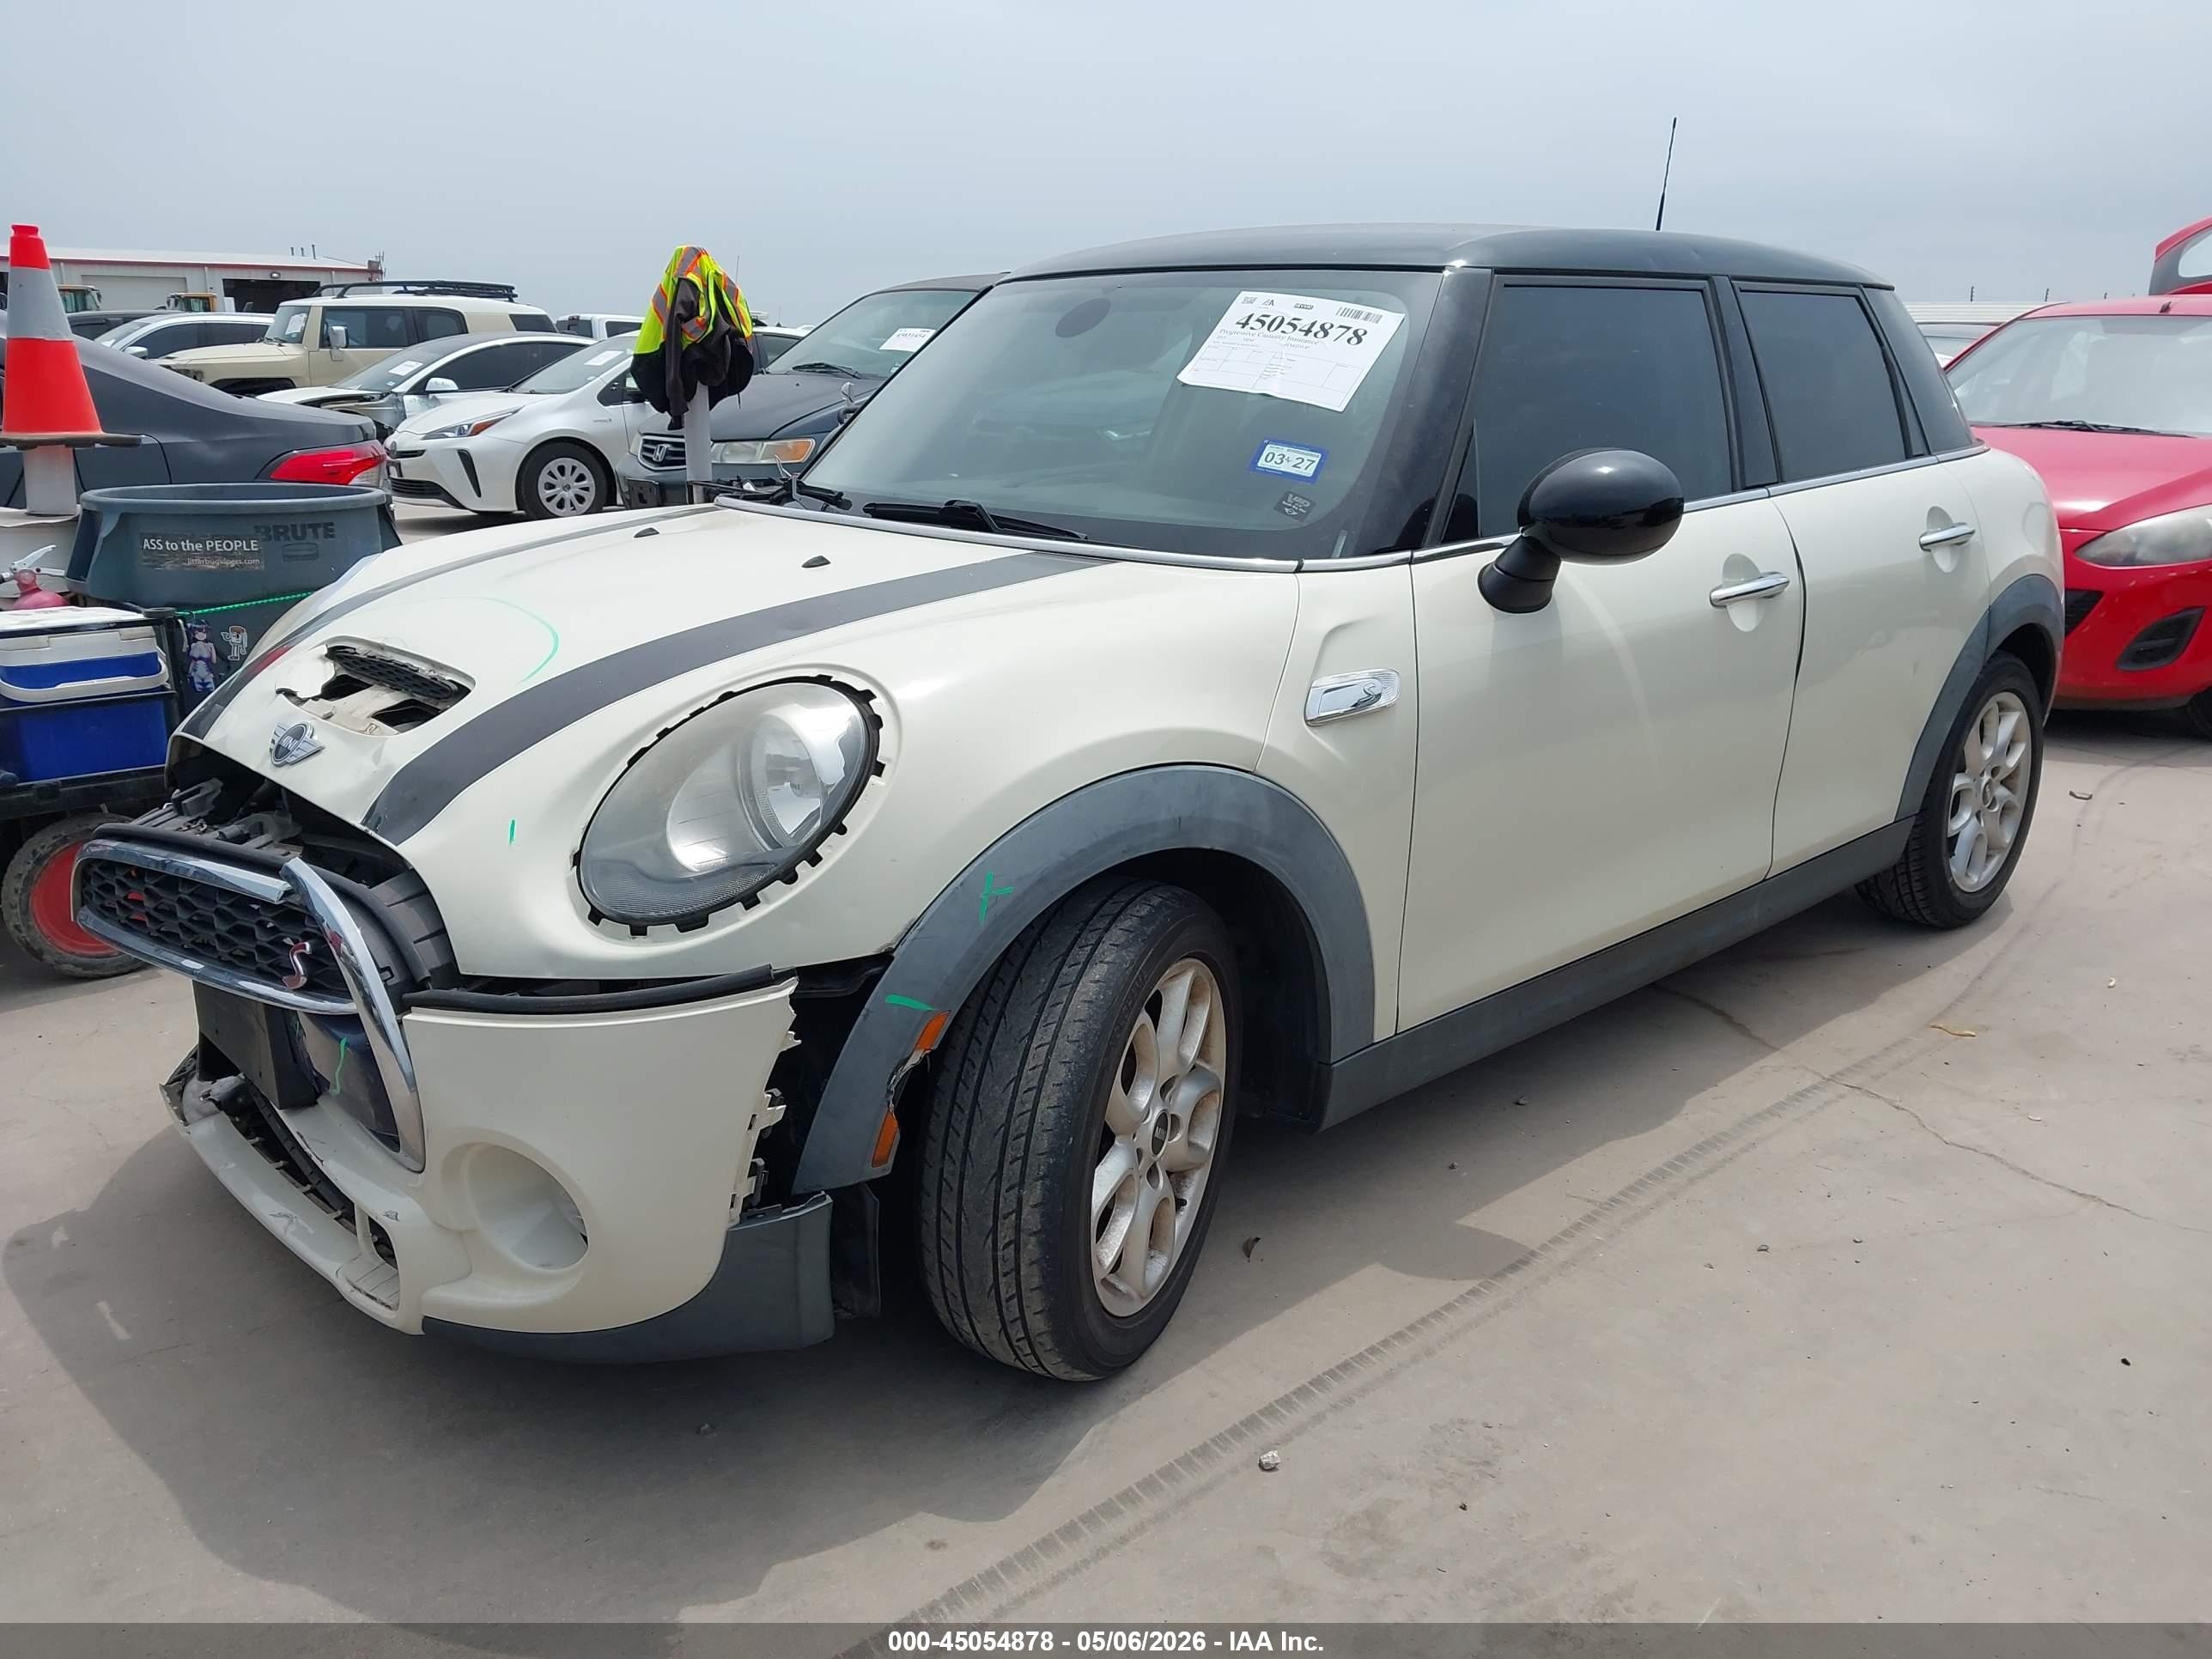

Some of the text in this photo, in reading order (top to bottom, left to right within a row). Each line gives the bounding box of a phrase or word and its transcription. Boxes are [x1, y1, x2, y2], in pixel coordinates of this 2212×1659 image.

[1236, 313, 1368, 345] 45054878
[1264, 452, 1285, 465] 03
[1291, 457, 1316, 471] 27
[254, 522, 335, 542] BRUTE
[143, 538, 258, 552] ASS to the PEOPLE
[282, 941, 312, 990] S
